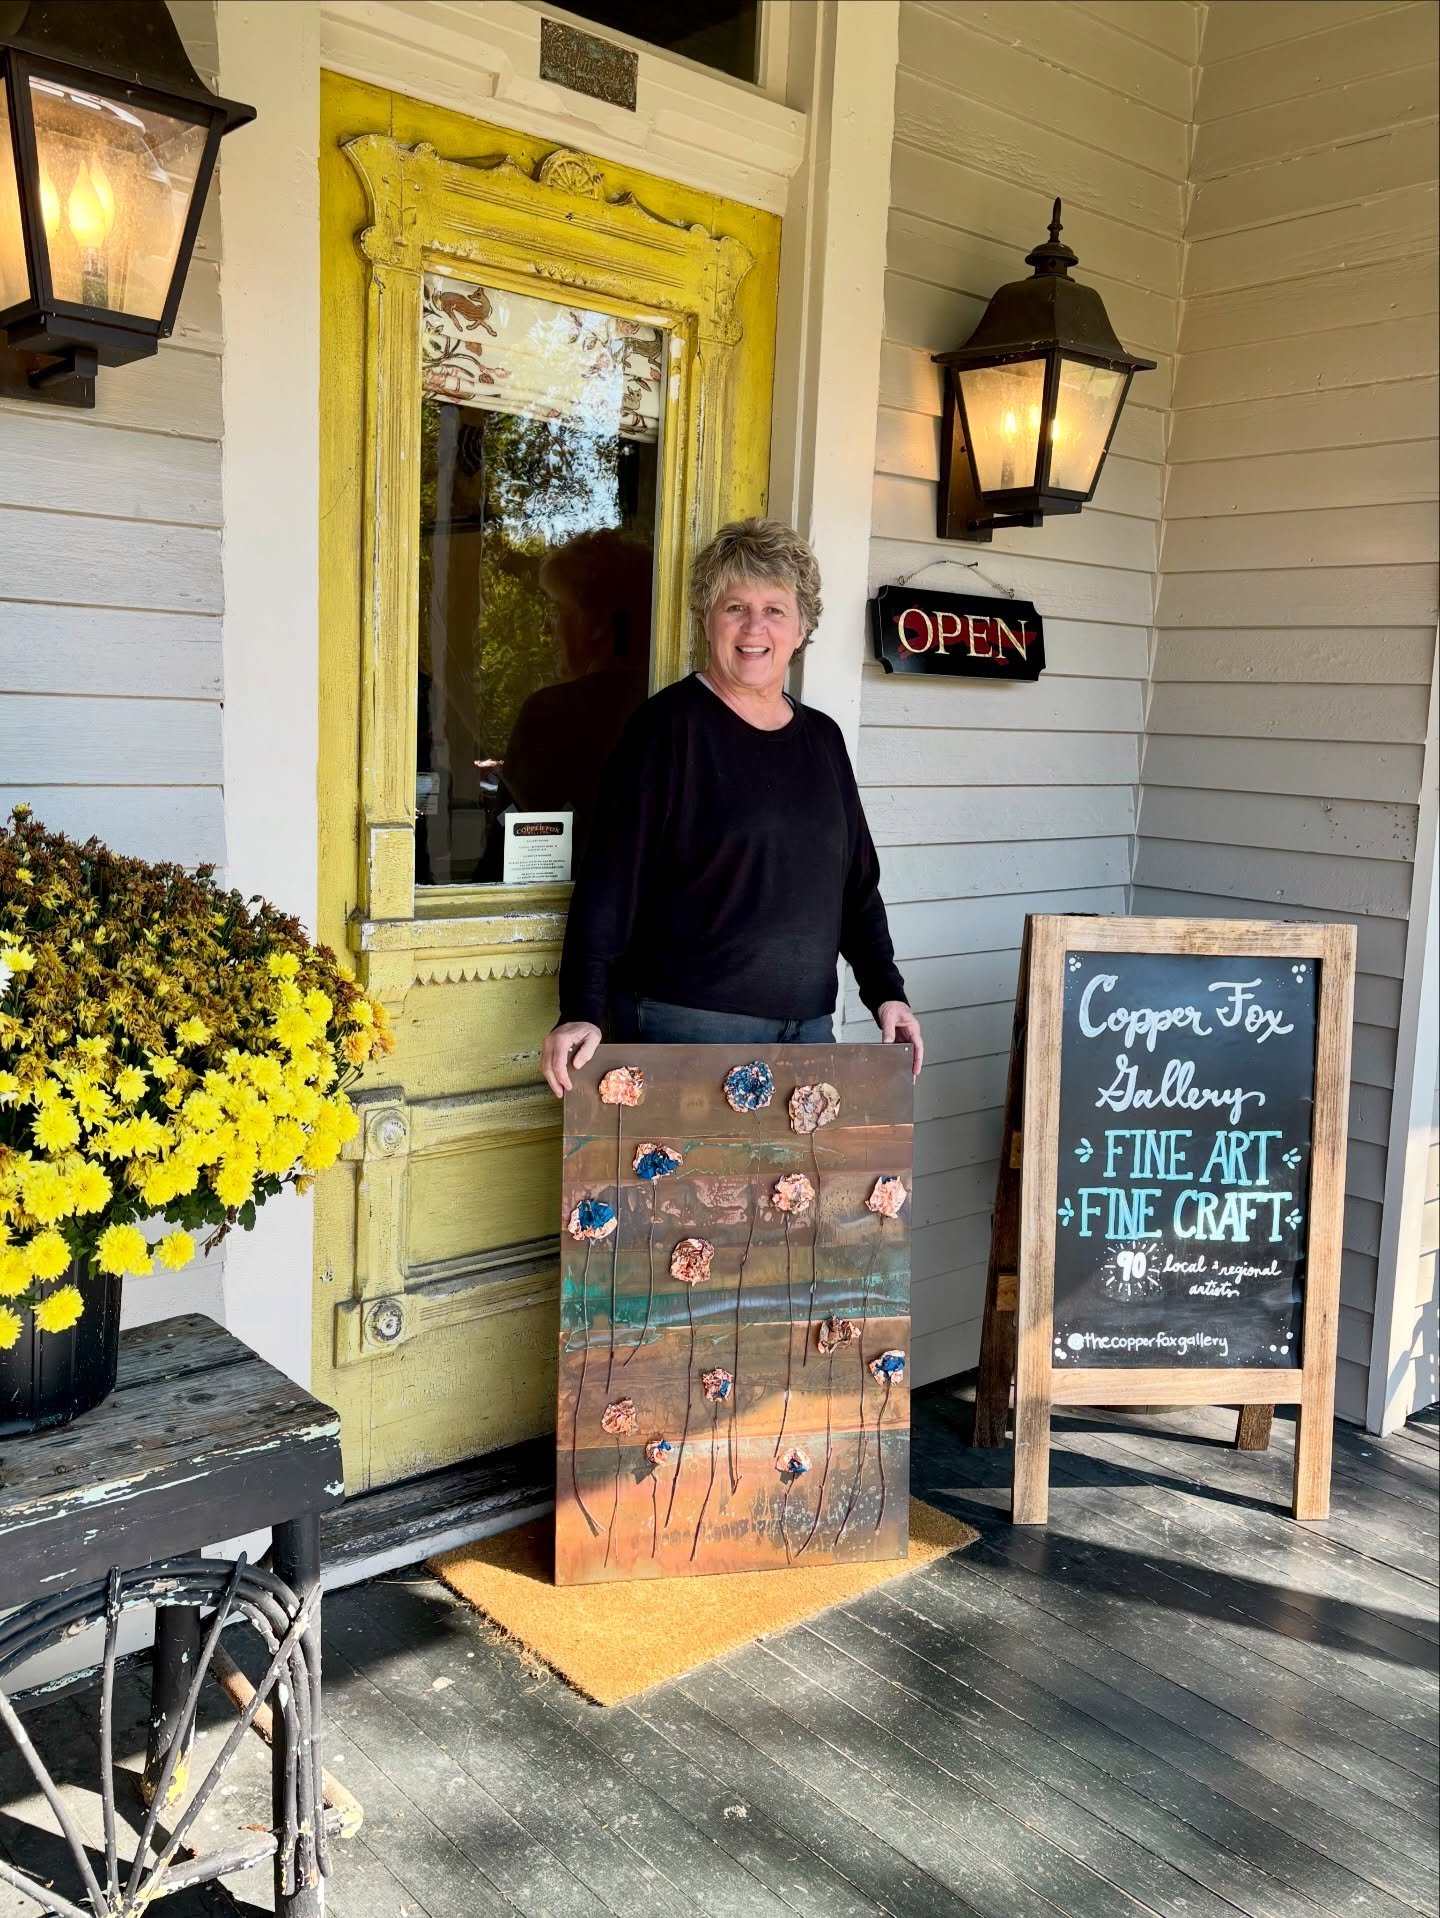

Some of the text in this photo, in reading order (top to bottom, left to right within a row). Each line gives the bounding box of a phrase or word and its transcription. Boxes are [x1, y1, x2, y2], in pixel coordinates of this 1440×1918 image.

[898, 608, 1029, 662] OPEN
[1079, 974, 1294, 1052] Copper Fox
[1095, 1054, 1266, 1125] Gallery
[1103, 1130, 1282, 1185] FINE ART
[1078, 1187, 1292, 1242] FINE CRAFT
[1117, 1251, 1147, 1281] 90
[1163, 1254, 1207, 1273] local
[1218, 1260, 1282, 1284] regional
[1189, 1280, 1240, 1298] artists
